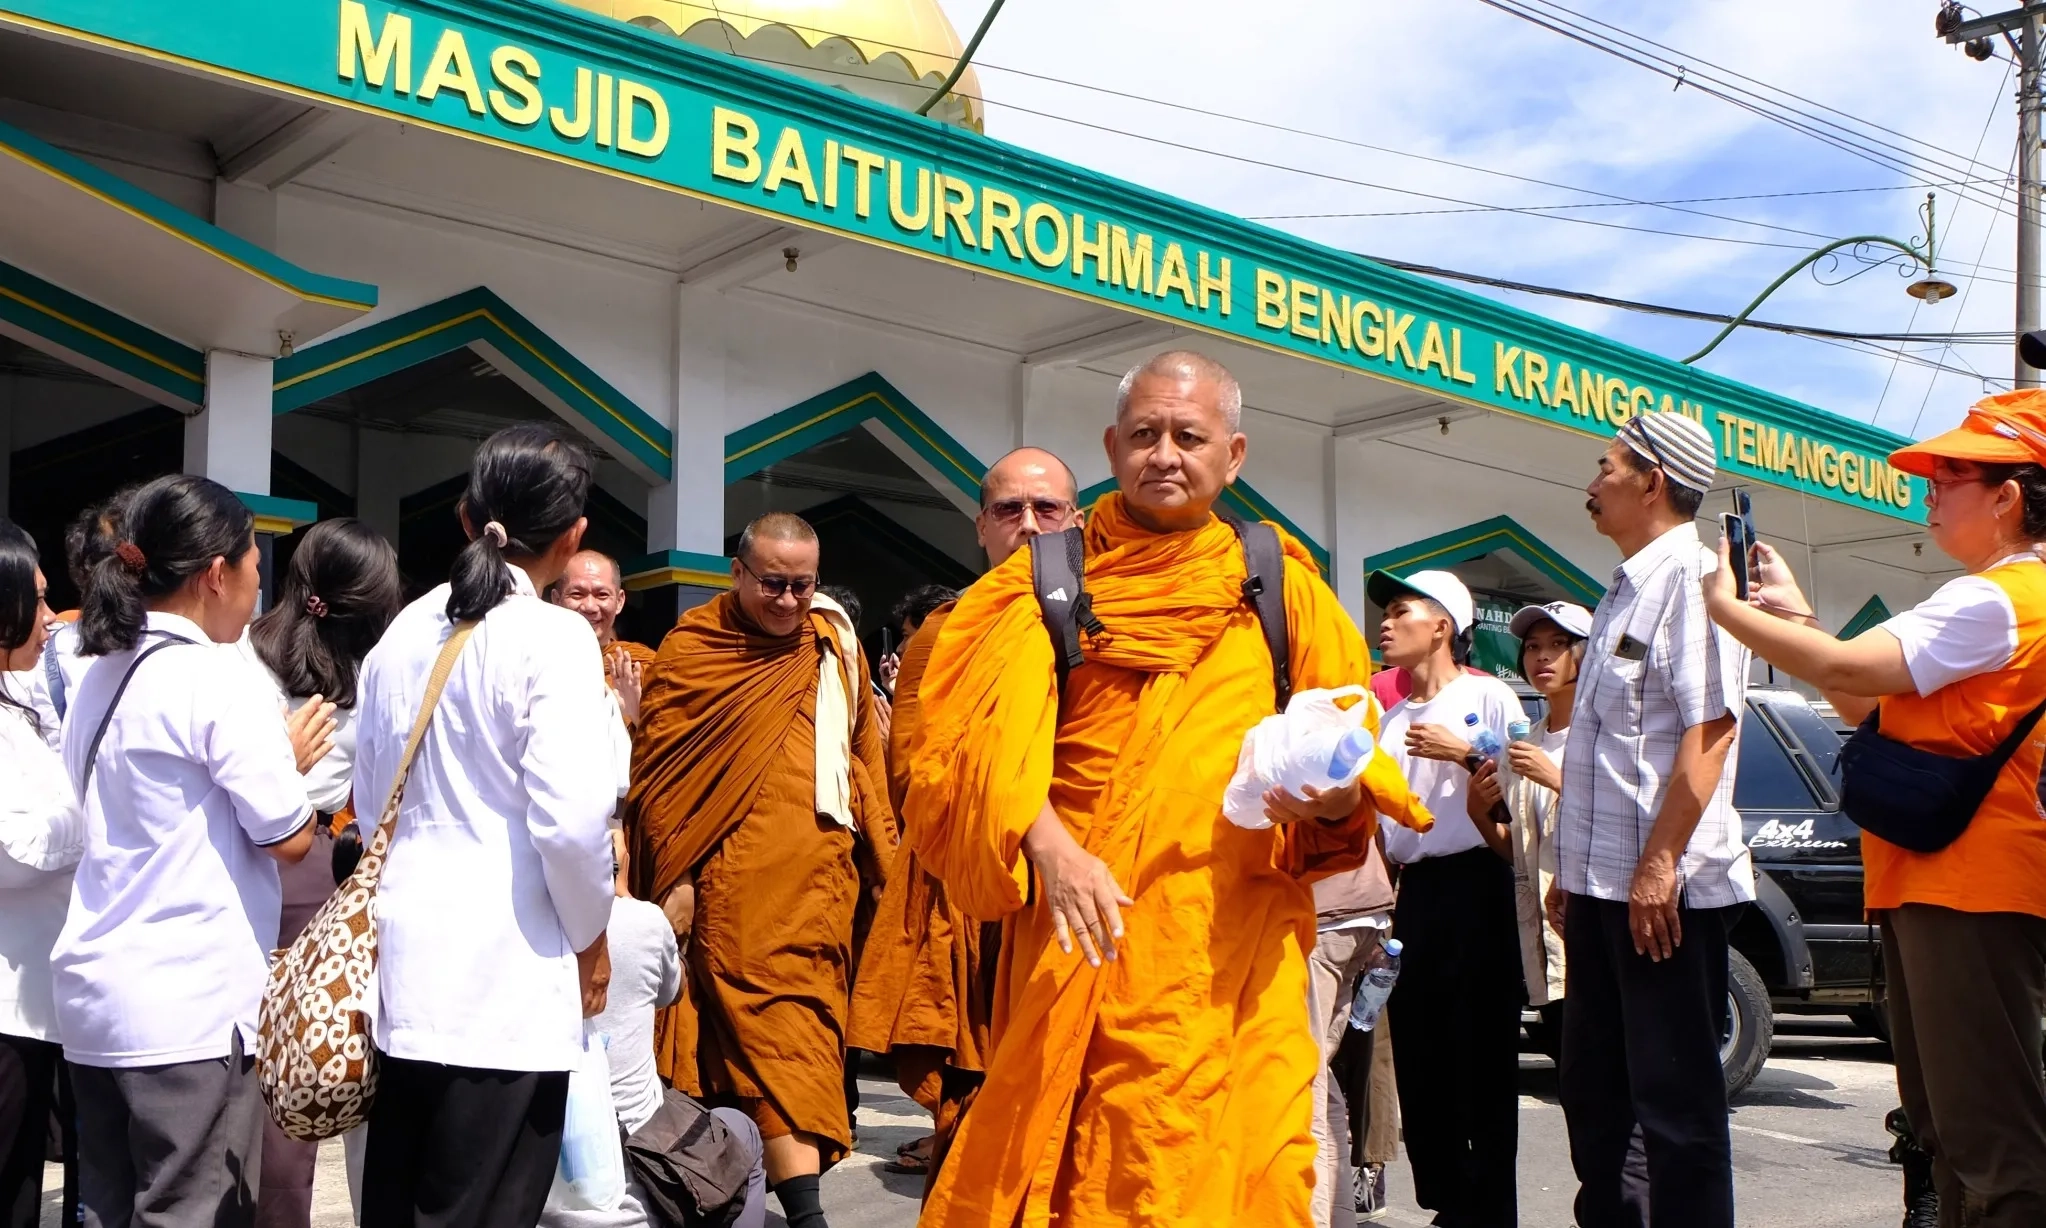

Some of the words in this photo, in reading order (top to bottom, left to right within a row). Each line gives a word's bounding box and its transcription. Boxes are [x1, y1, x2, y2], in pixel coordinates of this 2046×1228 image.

[337, 0, 670, 158] MASJID
[711, 105, 1231, 316] BAITURROHMAH
[1256, 268, 1476, 385] BENGKAL
[1716, 411, 1911, 508] TEMANGGUNG
[1476, 607, 1513, 624] NAHD
[1757, 818, 1814, 840] 4x4
